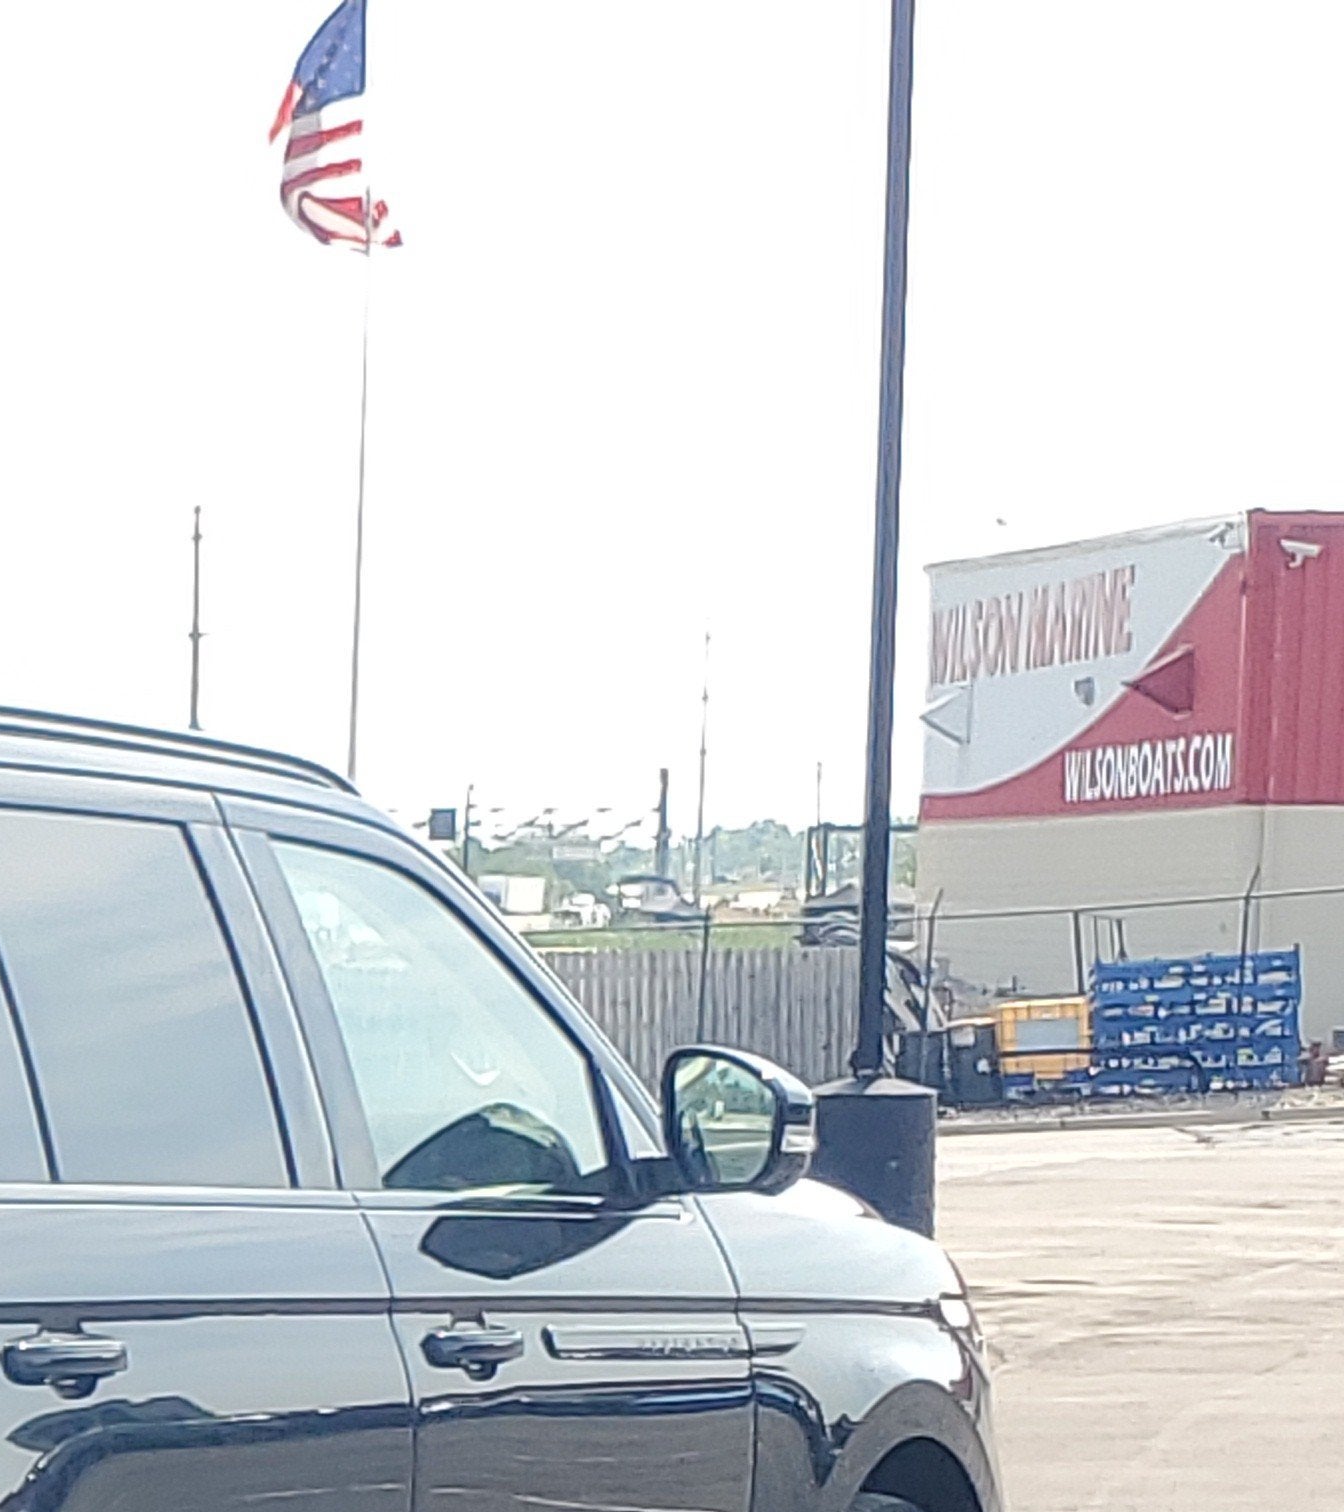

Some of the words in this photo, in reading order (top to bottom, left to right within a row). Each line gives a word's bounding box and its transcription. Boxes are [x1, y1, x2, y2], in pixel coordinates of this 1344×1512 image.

[933, 593, 1021, 684] WILSON
[1027, 565, 1134, 669] MARINE
[1065, 733, 1234, 803] WILSONBOATS.COM
